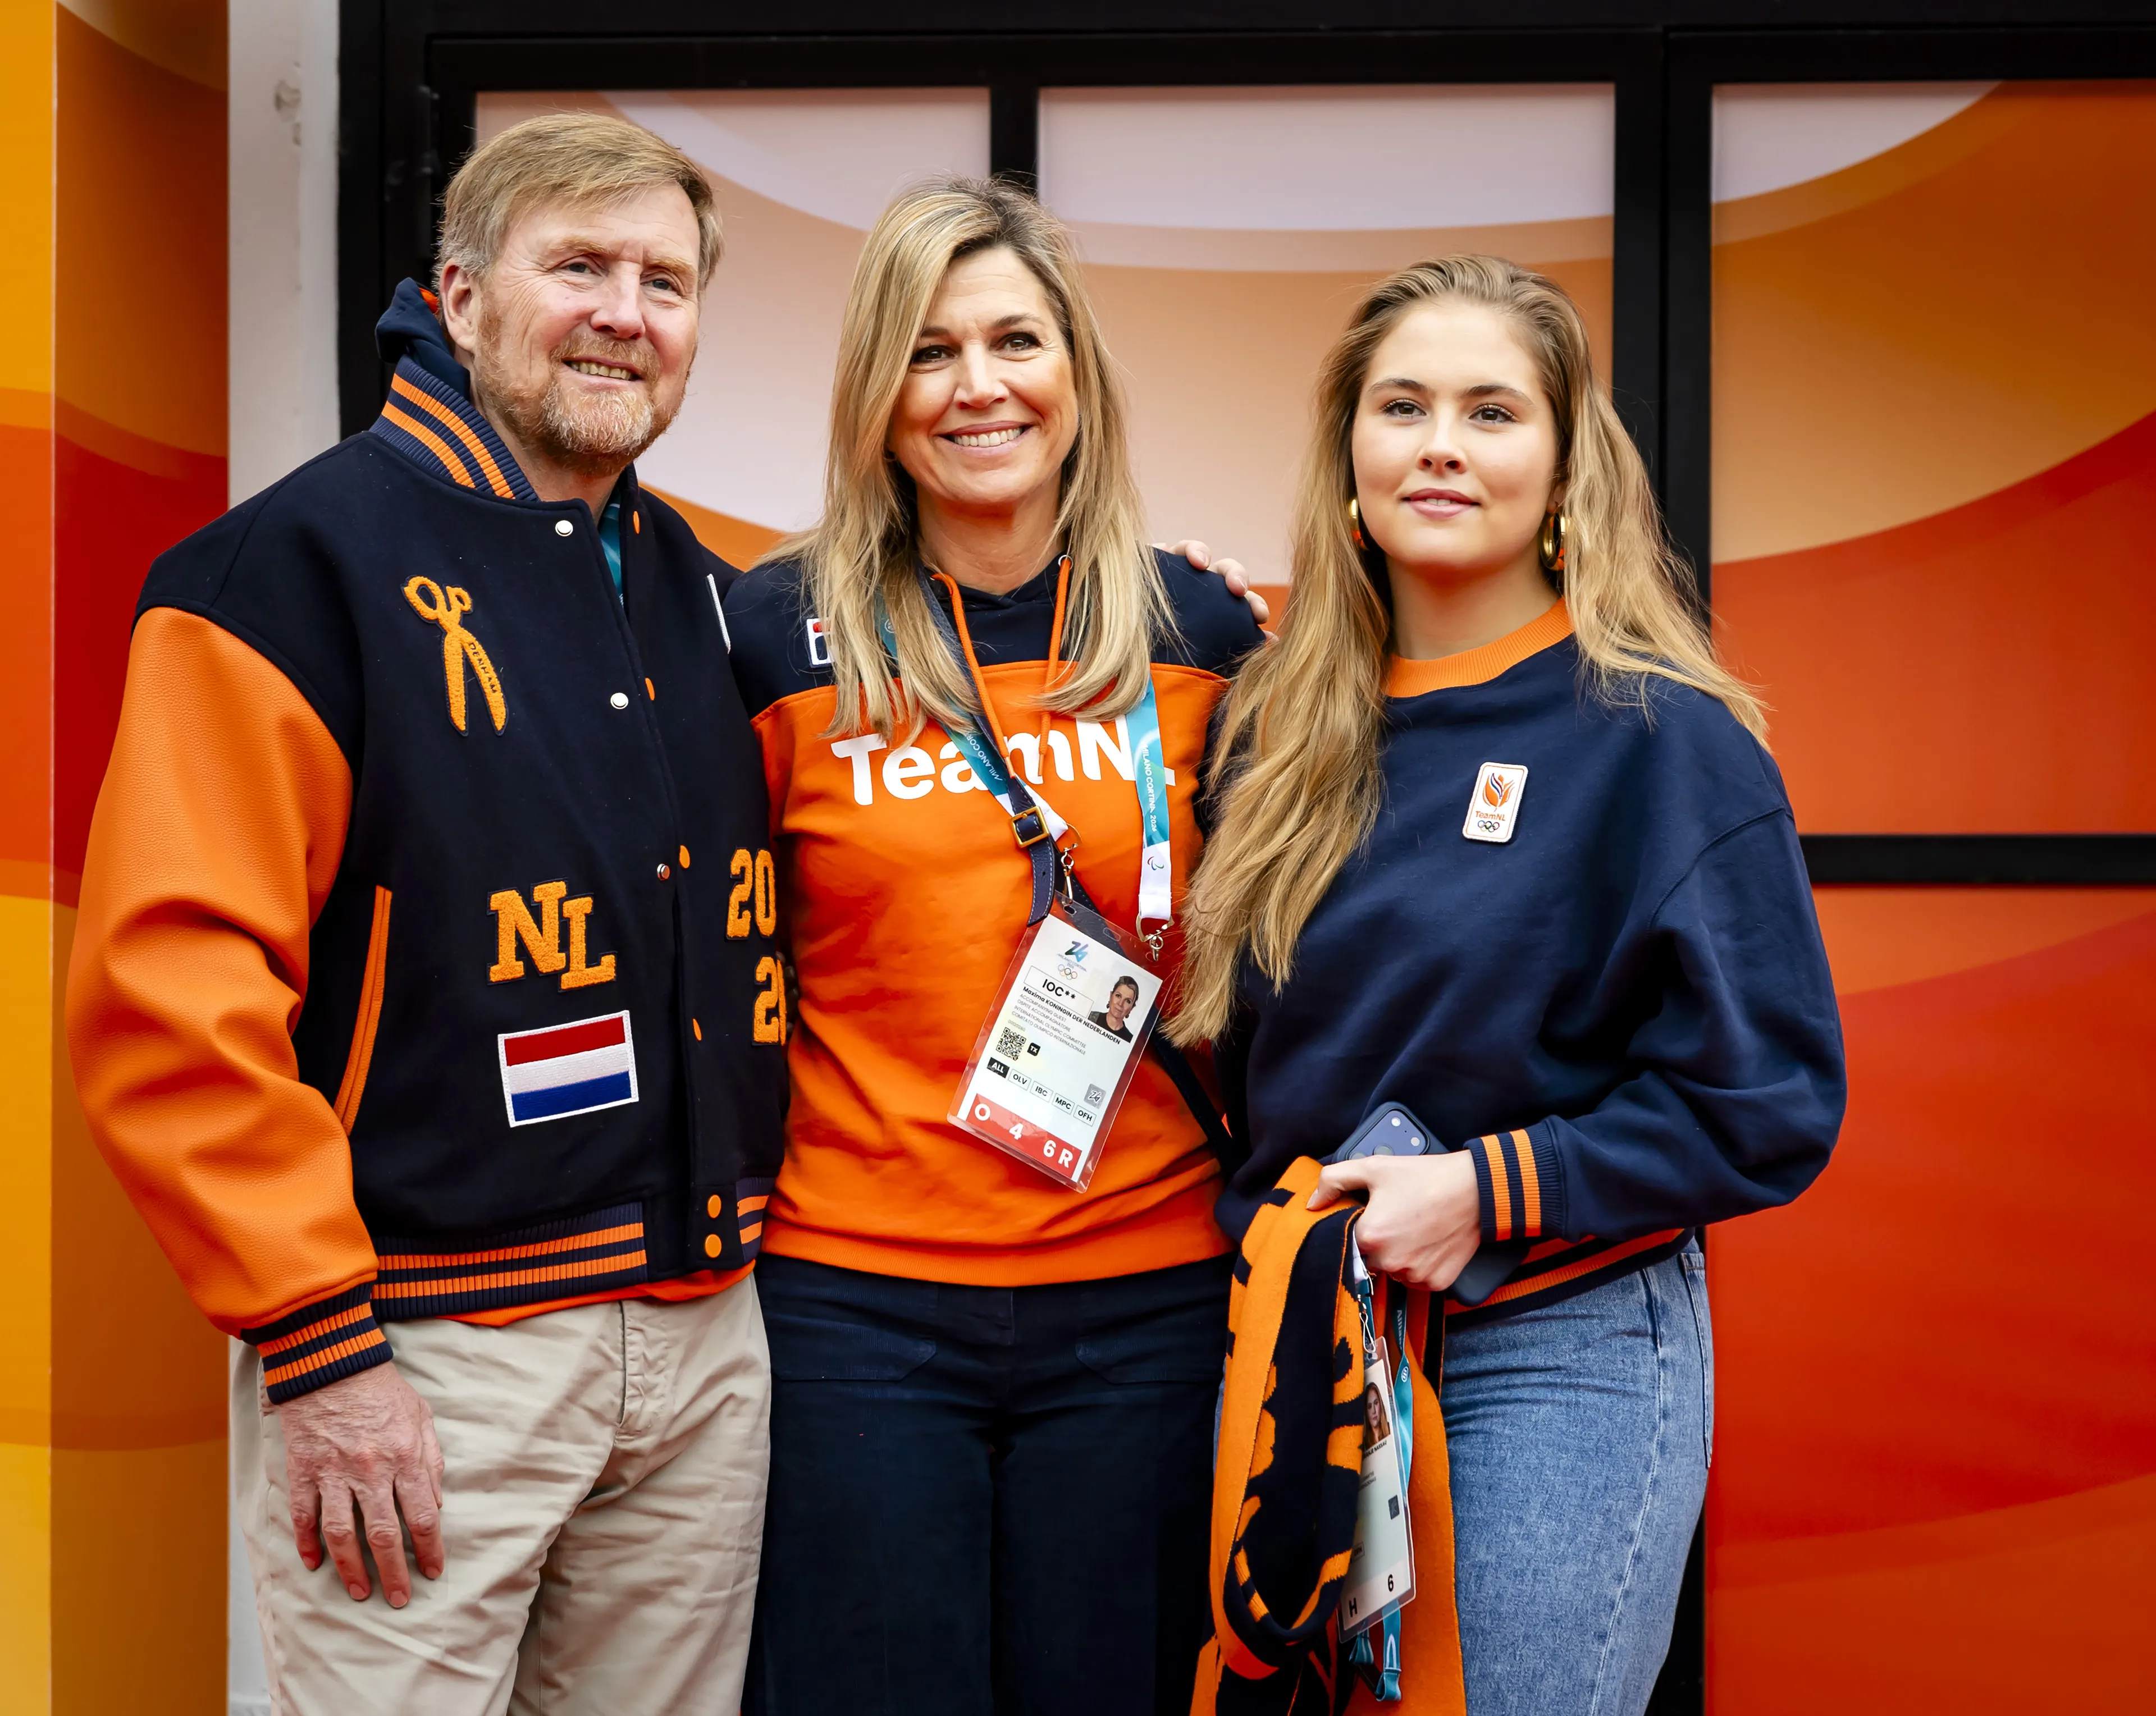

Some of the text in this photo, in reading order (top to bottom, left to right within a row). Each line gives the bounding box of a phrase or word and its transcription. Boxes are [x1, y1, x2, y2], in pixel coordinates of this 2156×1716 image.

[468, 642, 497, 693] DENHAM
[831, 715, 1176, 806] TeamN
[977, 751, 1003, 781] MILANO
[1141, 743, 1152, 778] MILANO
[1146, 778, 1156, 813] CORTINA
[1475, 811, 1506, 821] TeamNL
[726, 848, 777, 938] 20
[489, 880, 616, 990] NL
[752, 956, 787, 1046] 2
[1017, 999, 1071, 1032] OSPITE ACCOMPAGNATORE
[1020, 994, 1067, 1022] ACCOMPANYING GUEST
[1023, 986, 1121, 1045] Maxima KONINGIN DER NEDERLANDEN
[1012, 1011, 1086, 1055] COMITATO OLIMPICO INTERNAZIONALE
[1014, 1005, 1086, 1049] INTERNATIONAL OLYMPIC COMMITTEE
[1030, 1045, 1039, 1054] TX
[991, 1061, 1093, 1122] ALL OLV IBC MPC OFH
[1008, 1123, 1024, 1140] 4
[1349, 1573, 1394, 1617] H 6
